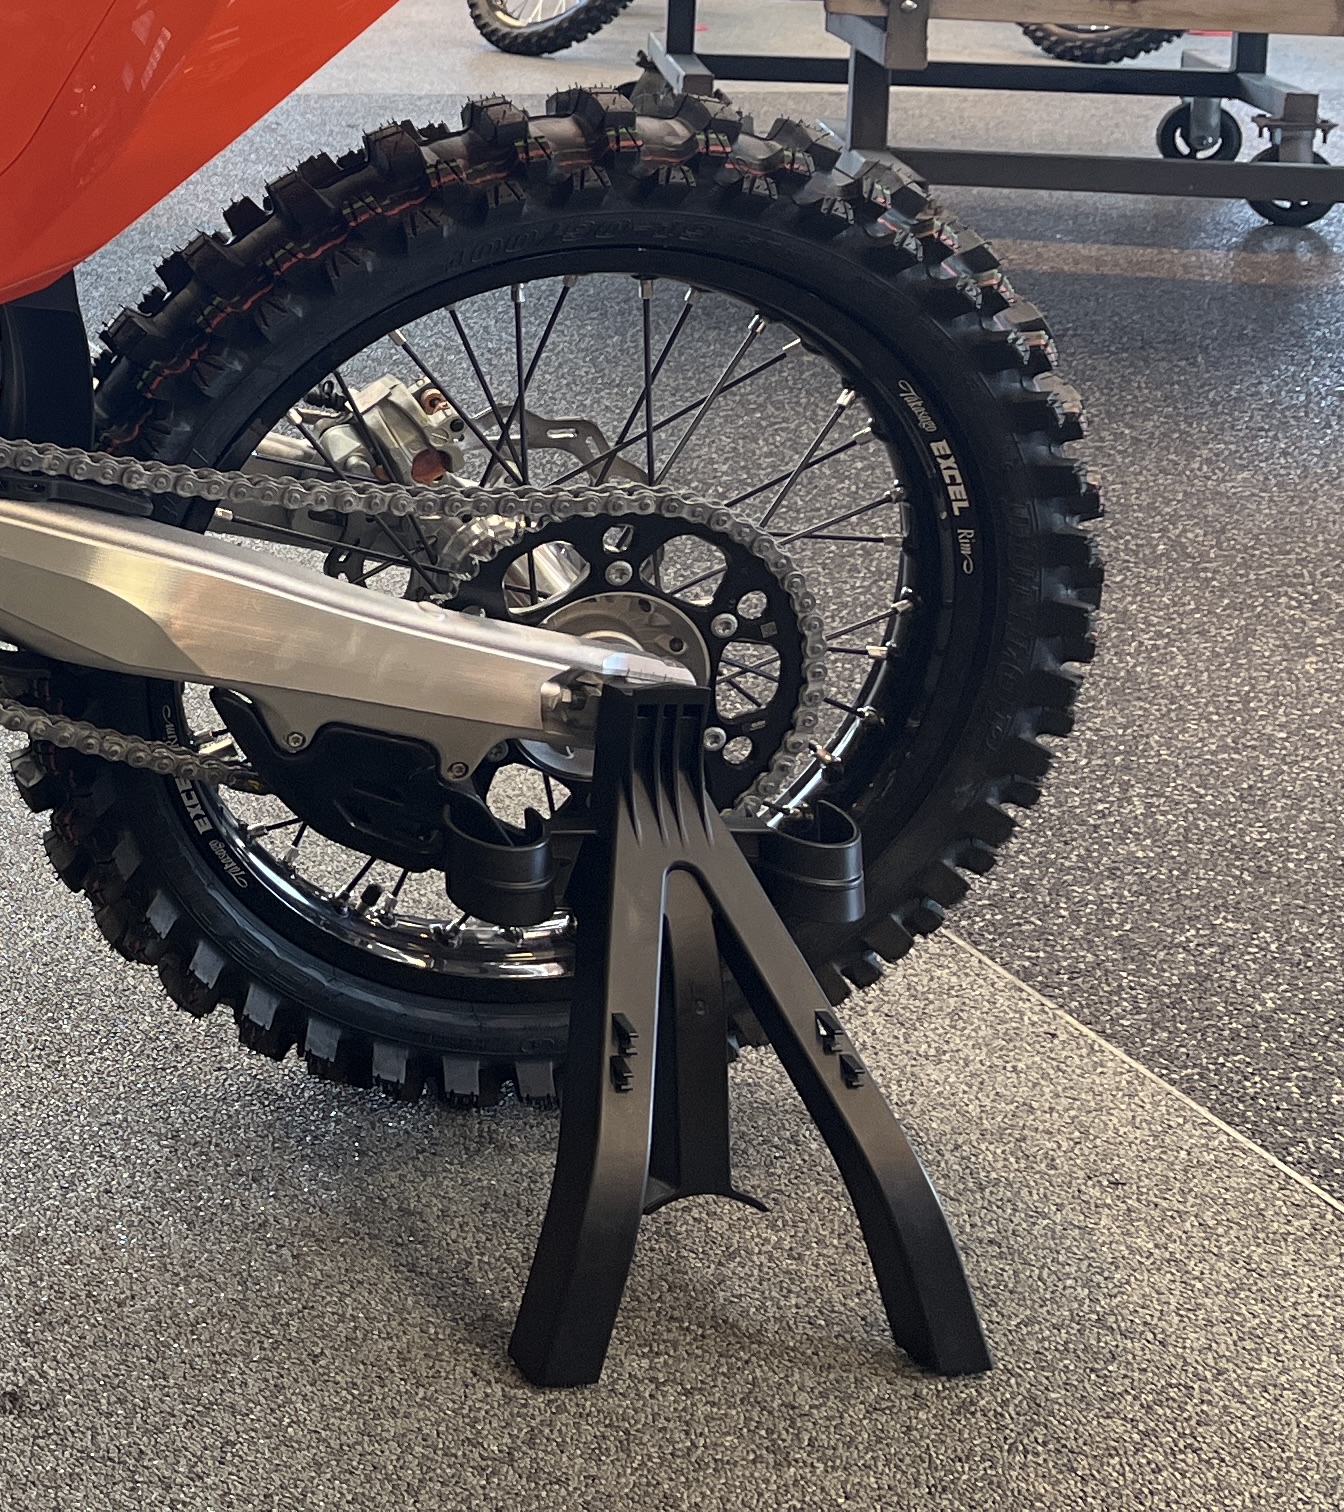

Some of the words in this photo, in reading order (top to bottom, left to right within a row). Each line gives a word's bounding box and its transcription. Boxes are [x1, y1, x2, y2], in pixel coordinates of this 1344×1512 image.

[897, 379, 938, 433] Takasago
[929, 438, 970, 517] EXCEL
[957, 528, 975, 575] Rim
[175, 777, 214, 835] EXCE
[209, 839, 248, 889] Takasago
